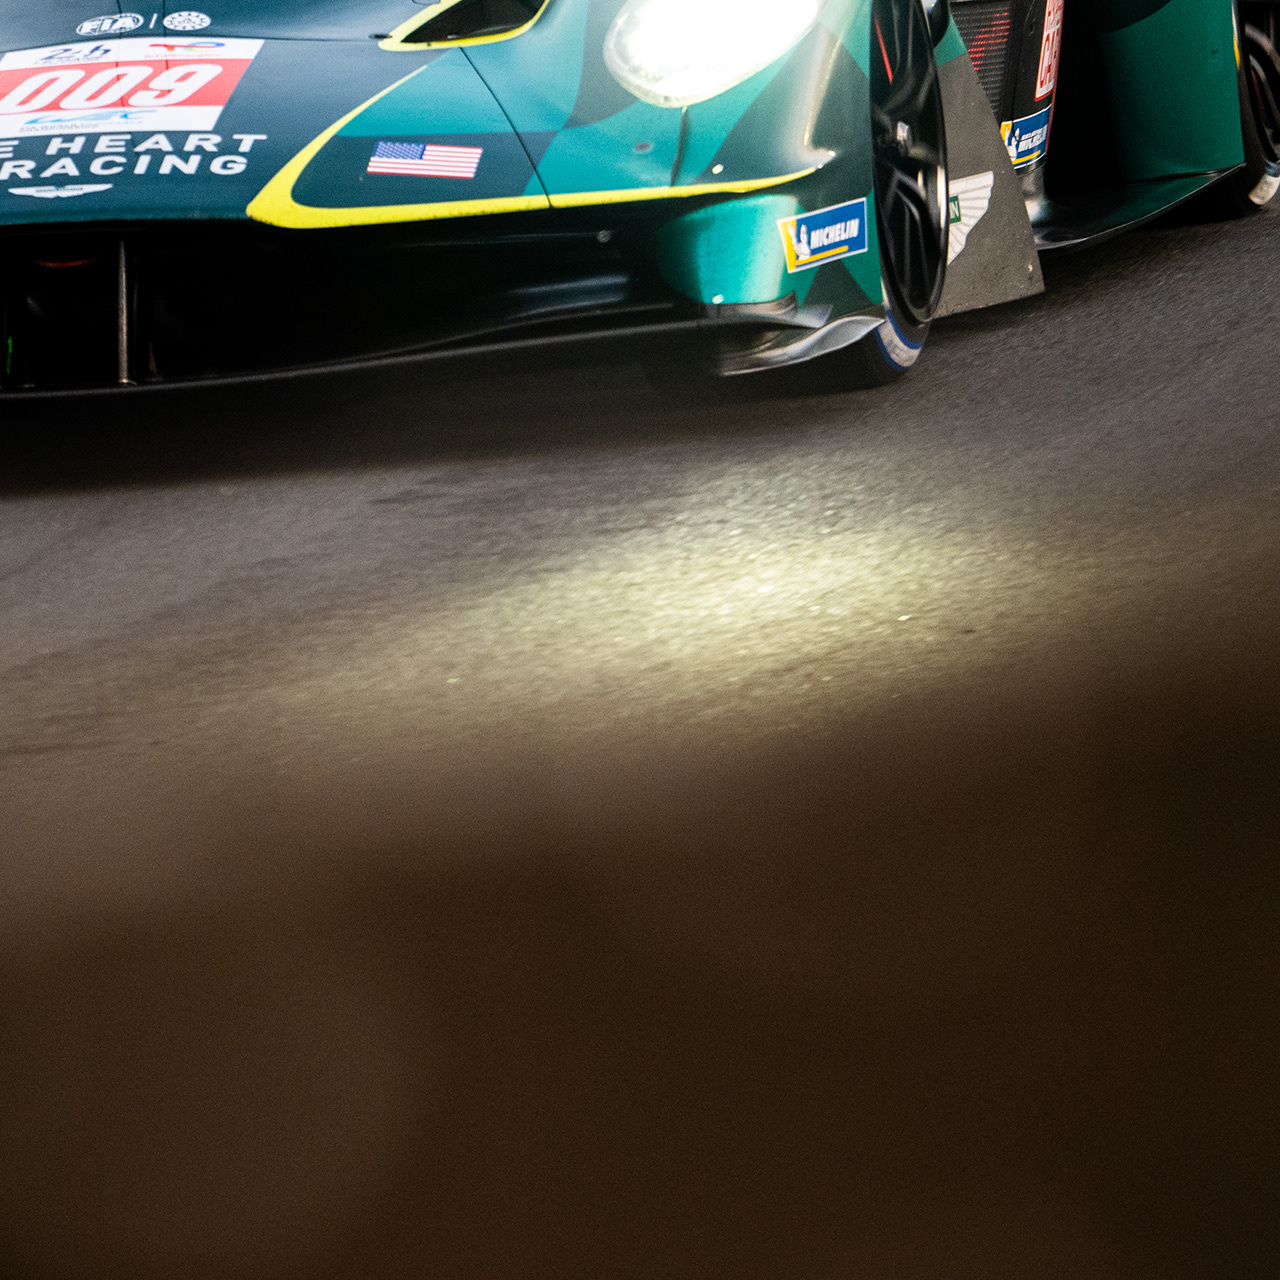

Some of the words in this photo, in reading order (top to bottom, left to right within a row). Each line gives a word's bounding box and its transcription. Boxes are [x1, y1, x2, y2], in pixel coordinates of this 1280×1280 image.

[81, 16, 136, 35] FIA
[45, 133, 267, 156] HEART
[810, 218, 859, 250] MICHELIN
